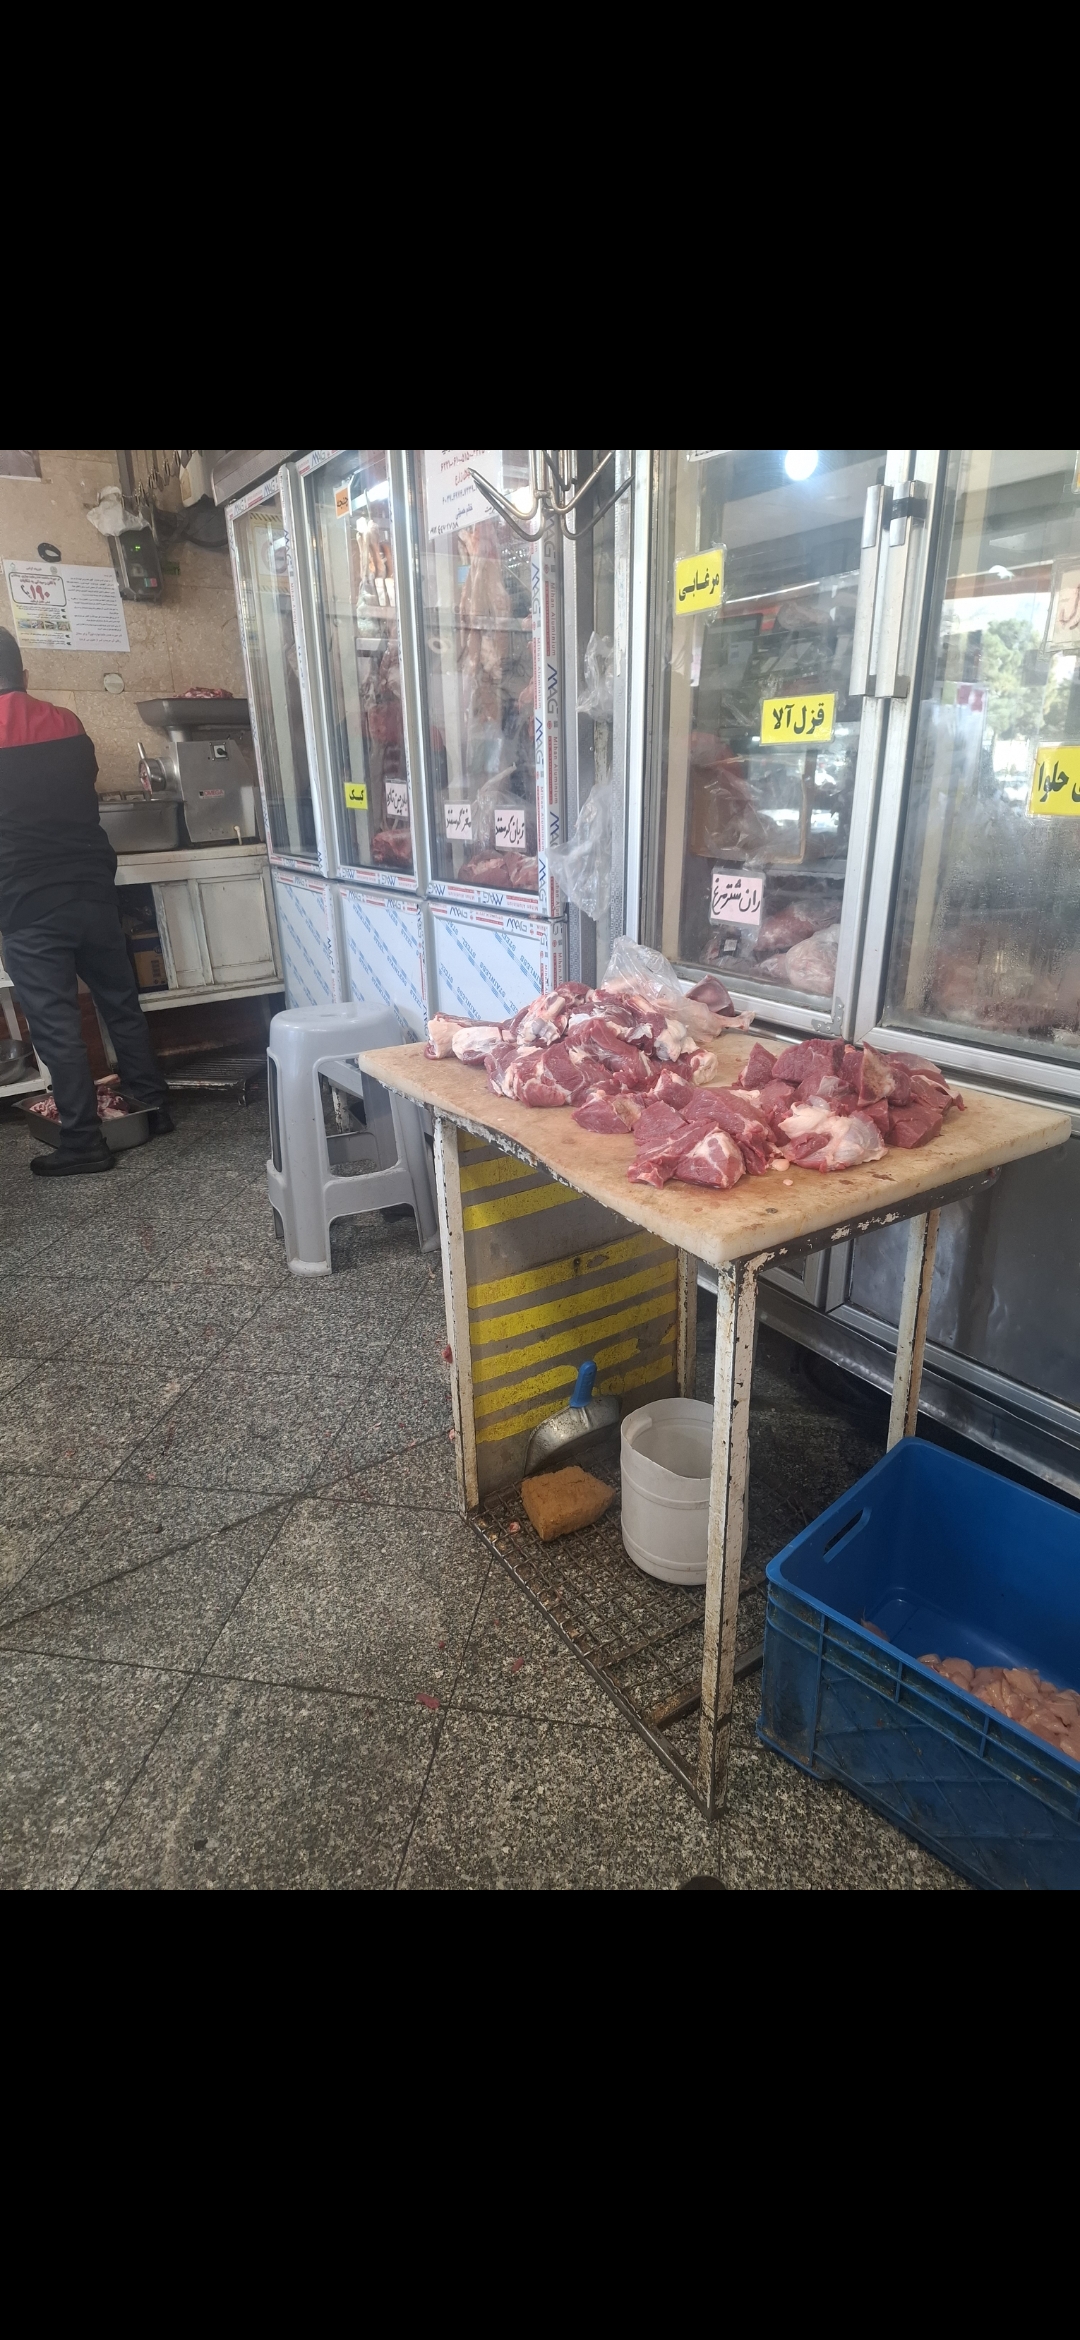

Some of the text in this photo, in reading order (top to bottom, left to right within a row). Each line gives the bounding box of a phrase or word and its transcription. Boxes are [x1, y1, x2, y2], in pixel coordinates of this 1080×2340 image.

[30, 584, 50, 600] ۱۹۰
[532, 562, 541, 615] MAG
[678, 568, 720, 602] مرغابی
[547, 664, 558, 714] MAG
[772, 702, 824, 734] قزل آلا
[536, 717, 544, 765] MAG
[1038, 760, 1070, 802] حلوا
[446, 808, 472, 832] مغز گوسفند
[495, 816, 525, 844] زبان گوسفند
[538, 858, 548, 902] MAG
[450, 906, 468, 918] MAG
[483, 891, 503, 906] MAG
[739, 888, 761, 913] ران
[507, 917, 527, 932] MAG
[462, 936, 476, 958] STEEL
[502, 933, 516, 952] STEEL
[387, 956, 407, 986] STAINLESS
[440, 962, 453, 983] STEEL
[480, 962, 506, 997] STAINLESS
[410, 989, 422, 1008] STEEL
[456, 987, 481, 1020] STAINLESS
